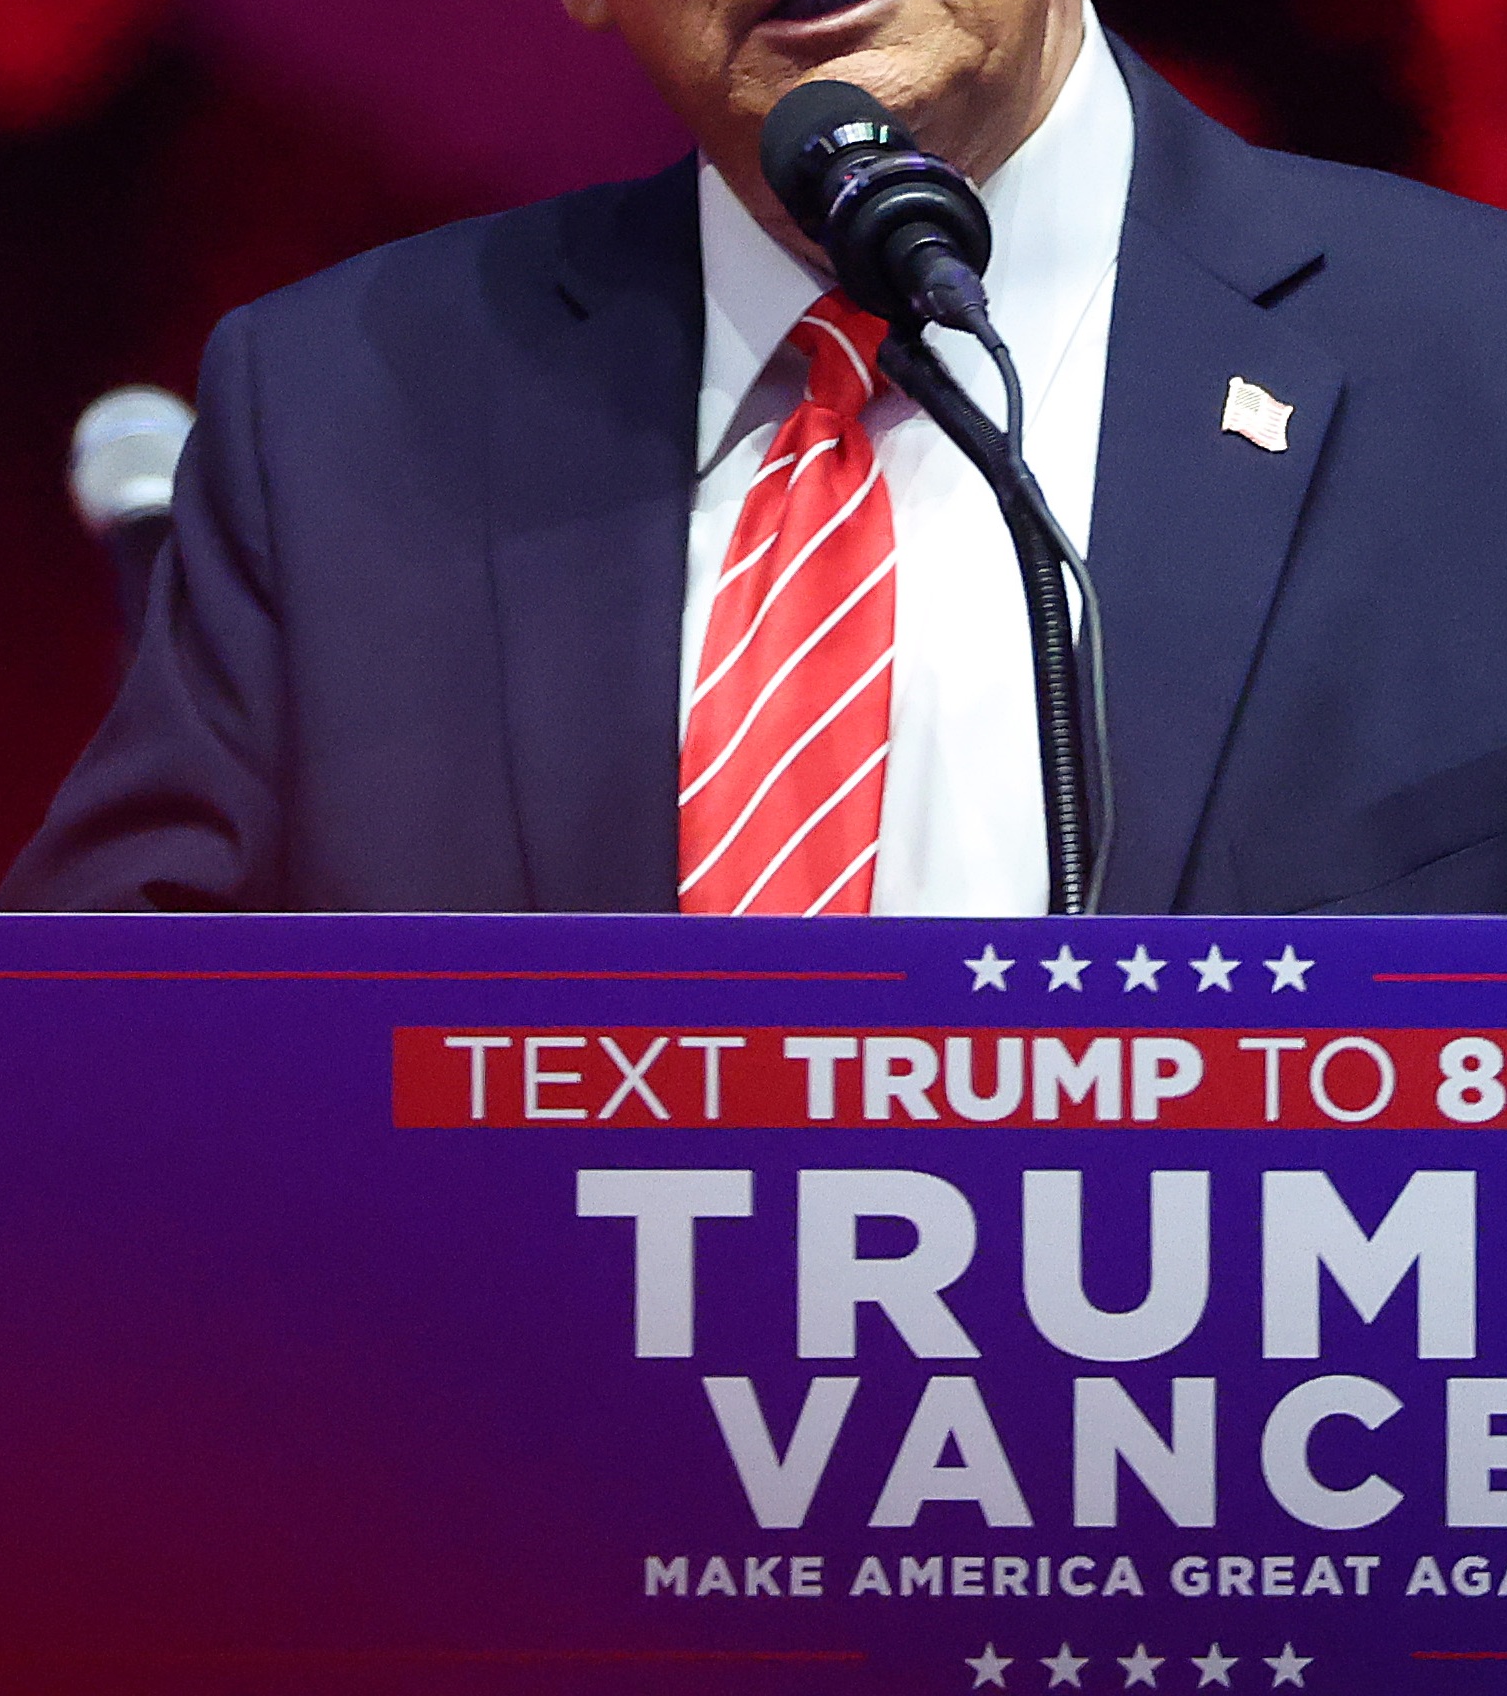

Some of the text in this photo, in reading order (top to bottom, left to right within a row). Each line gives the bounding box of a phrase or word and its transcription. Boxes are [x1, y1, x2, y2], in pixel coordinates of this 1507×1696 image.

[446, 1037, 747, 1121] TEXT
[785, 1038, 1205, 1122] TRUMP
[1239, 1038, 1396, 1123] TO
[647, 1558, 823, 1597] MAKE
[851, 1557, 1144, 1596] AMERICA
[1173, 1557, 1381, 1597] GREAT
